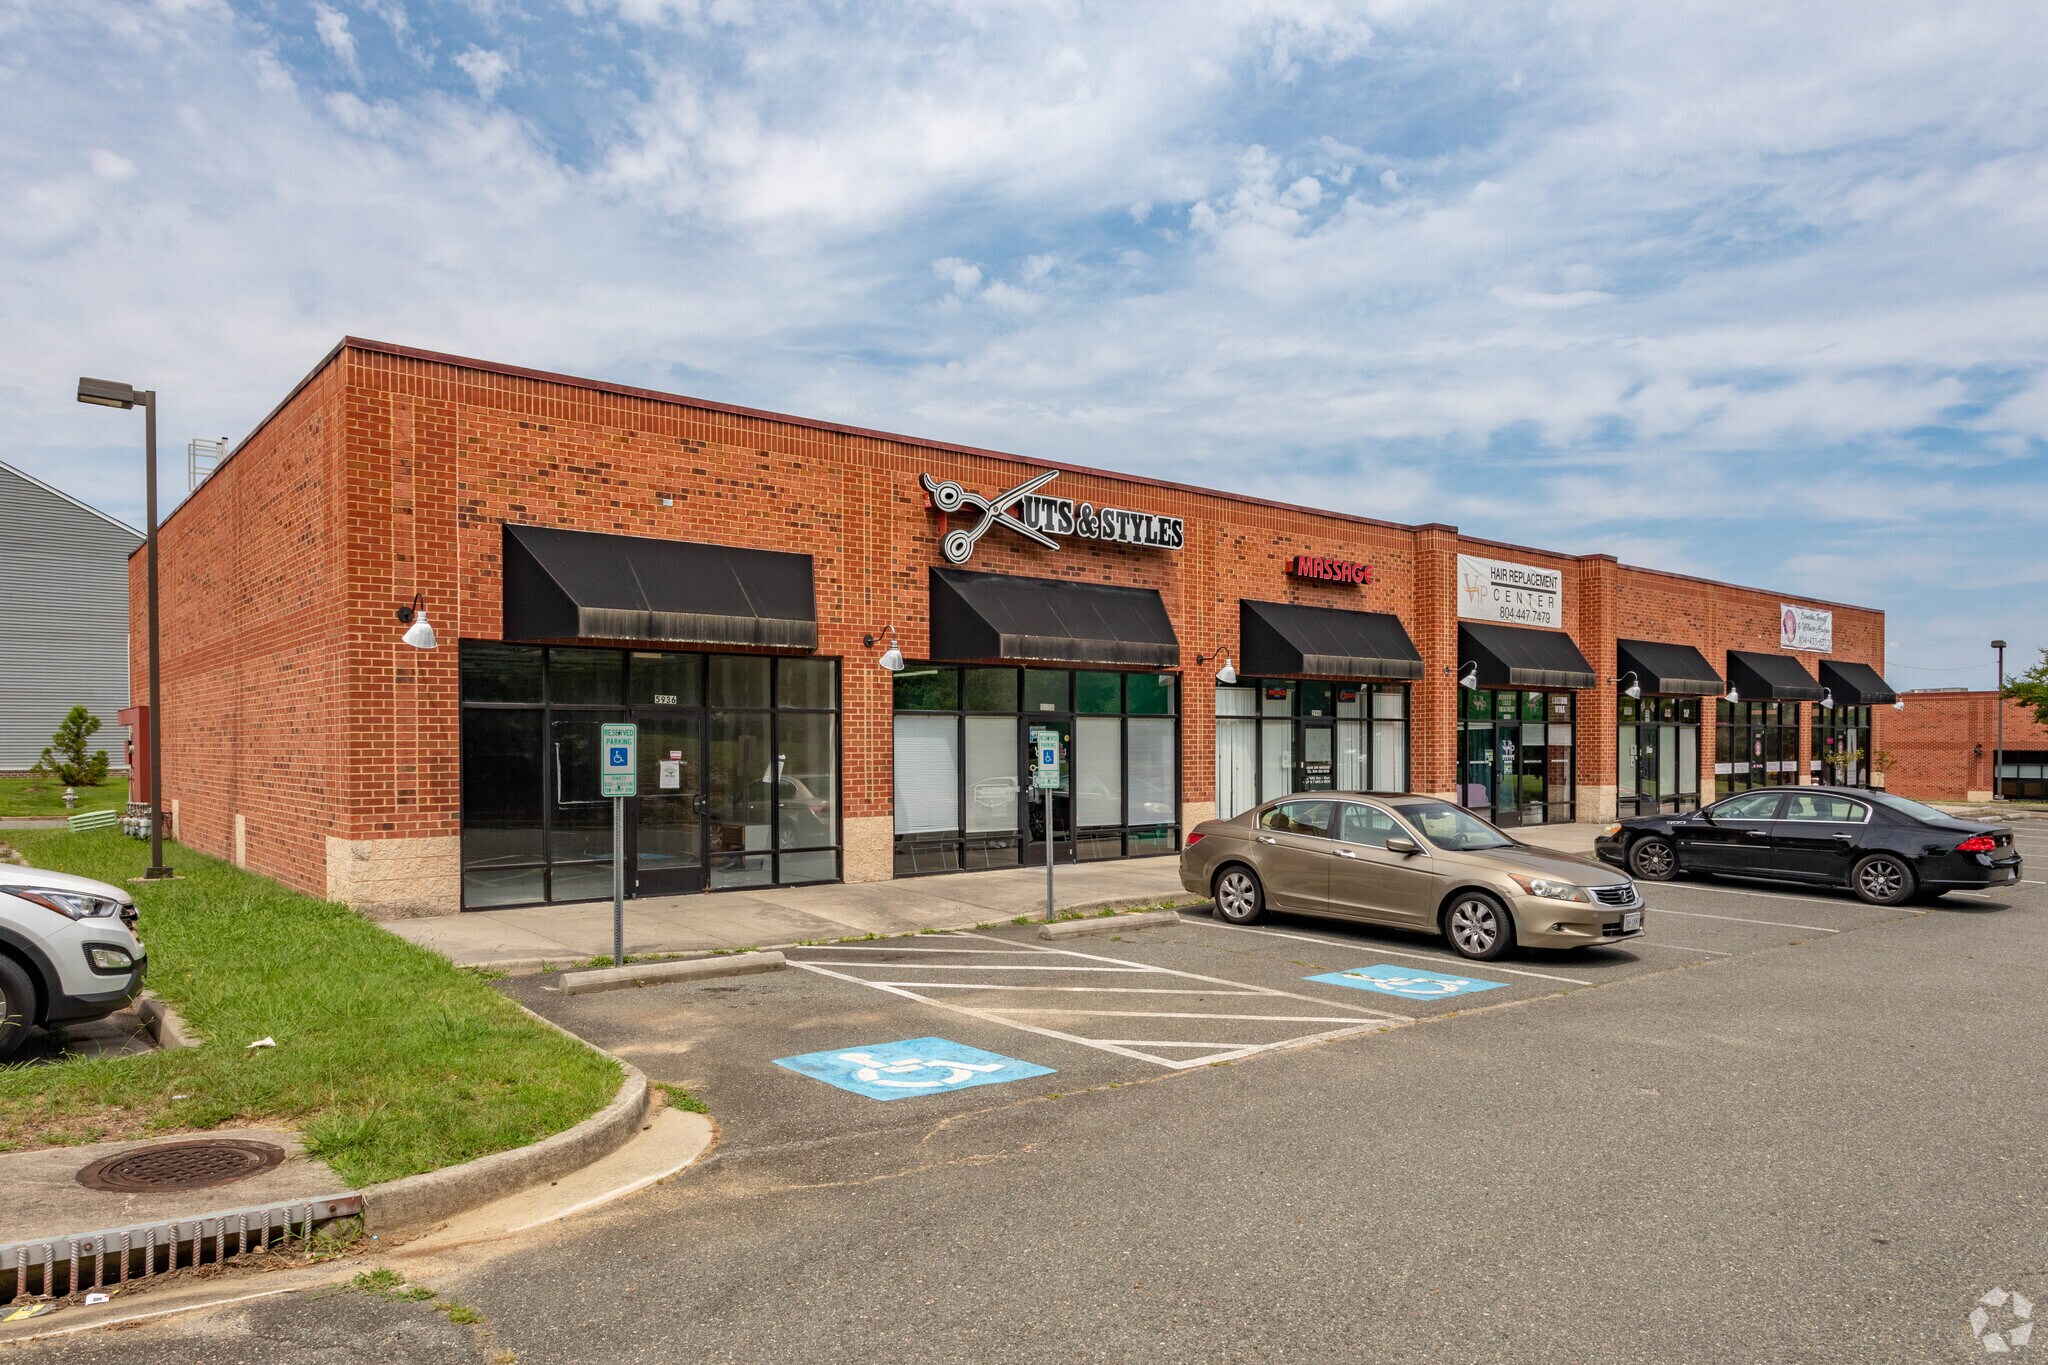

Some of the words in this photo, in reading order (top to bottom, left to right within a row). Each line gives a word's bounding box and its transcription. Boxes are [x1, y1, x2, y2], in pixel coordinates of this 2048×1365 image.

[1298, 555, 1373, 584] MASSAGE
[1491, 566, 1507, 582] HAIR
[1509, 569, 1558, 590] REPLACEMENT
[1493, 588, 1555, 608] CENTER
[1499, 606, 1551, 624] 804.447.7479
[655, 695, 676, 704] 5936
[604, 728, 634, 737] RESERVED
